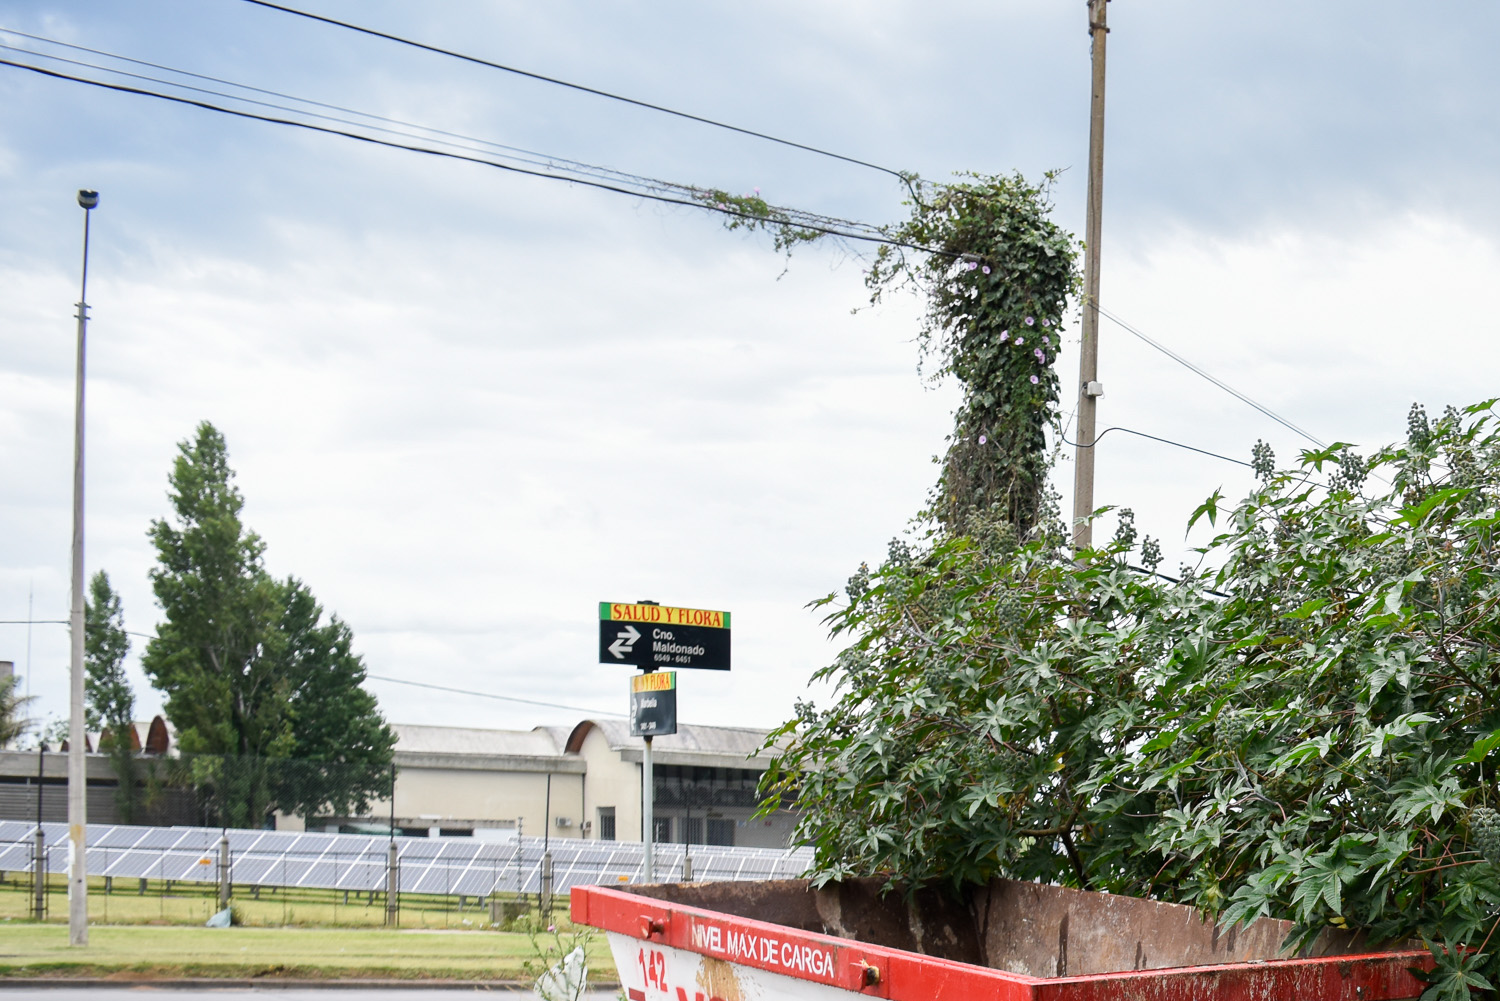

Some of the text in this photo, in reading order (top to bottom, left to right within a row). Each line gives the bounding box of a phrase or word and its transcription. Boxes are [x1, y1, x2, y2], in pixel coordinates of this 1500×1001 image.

[613, 604, 721, 626] SALUD Y FLORA
[652, 628, 675, 640] Cno.
[652, 641, 704, 656] Maldonado
[691, 924, 835, 978] NIVEL MAX DE CARGA
[638, 948, 668, 992] 142
